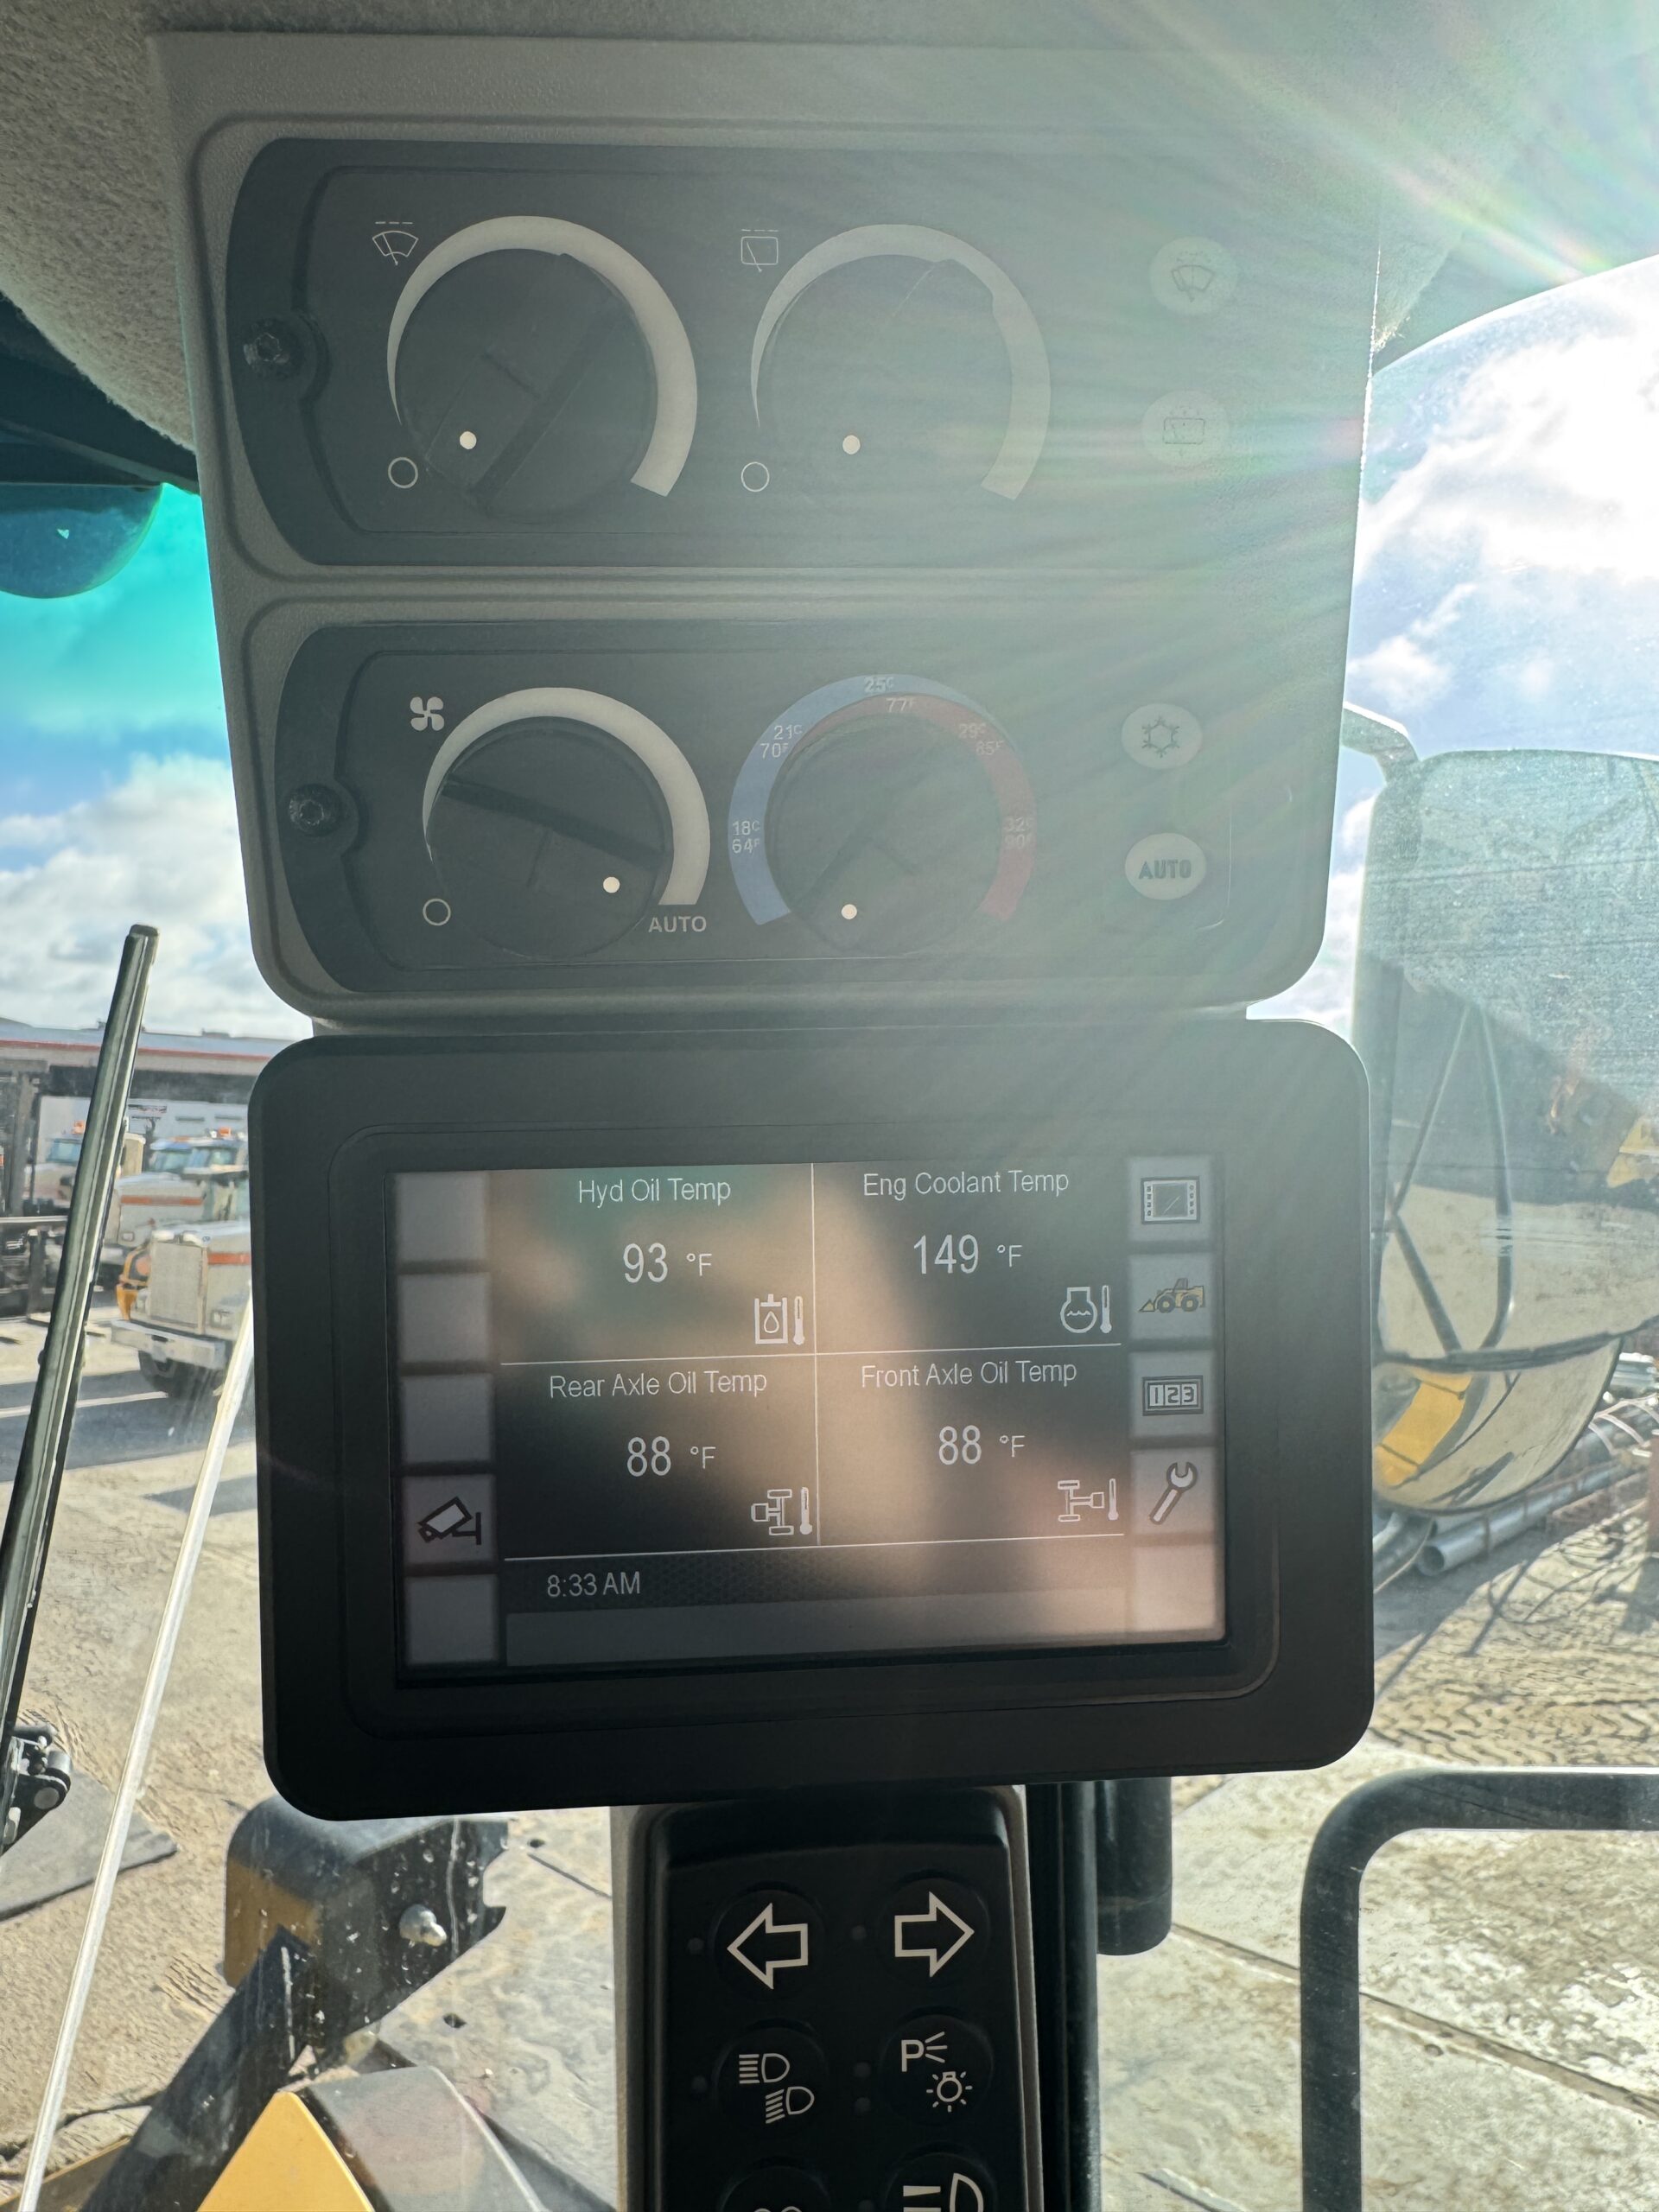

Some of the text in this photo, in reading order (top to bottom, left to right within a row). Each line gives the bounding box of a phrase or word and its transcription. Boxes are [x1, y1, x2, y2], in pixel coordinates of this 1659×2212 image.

[1138, 857, 1192, 880] AUTO
[648, 915, 707, 934] AUTO
[577, 1177, 732, 1209] Hyd Oil Temp
[862, 1169, 1070, 1201] Eng Coolant Temp
[622, 1242, 669, 1283] 93
[912, 1233, 979, 1274] 149
[549, 1370, 767, 1399] Rear Axle Oil Temp
[861, 1359, 1077, 1389] Front Axle Oil Temp
[626, 1435, 672, 1478] 88
[938, 1424, 982, 1465] 88
[546, 1571, 641, 1598] 8:33 AM
